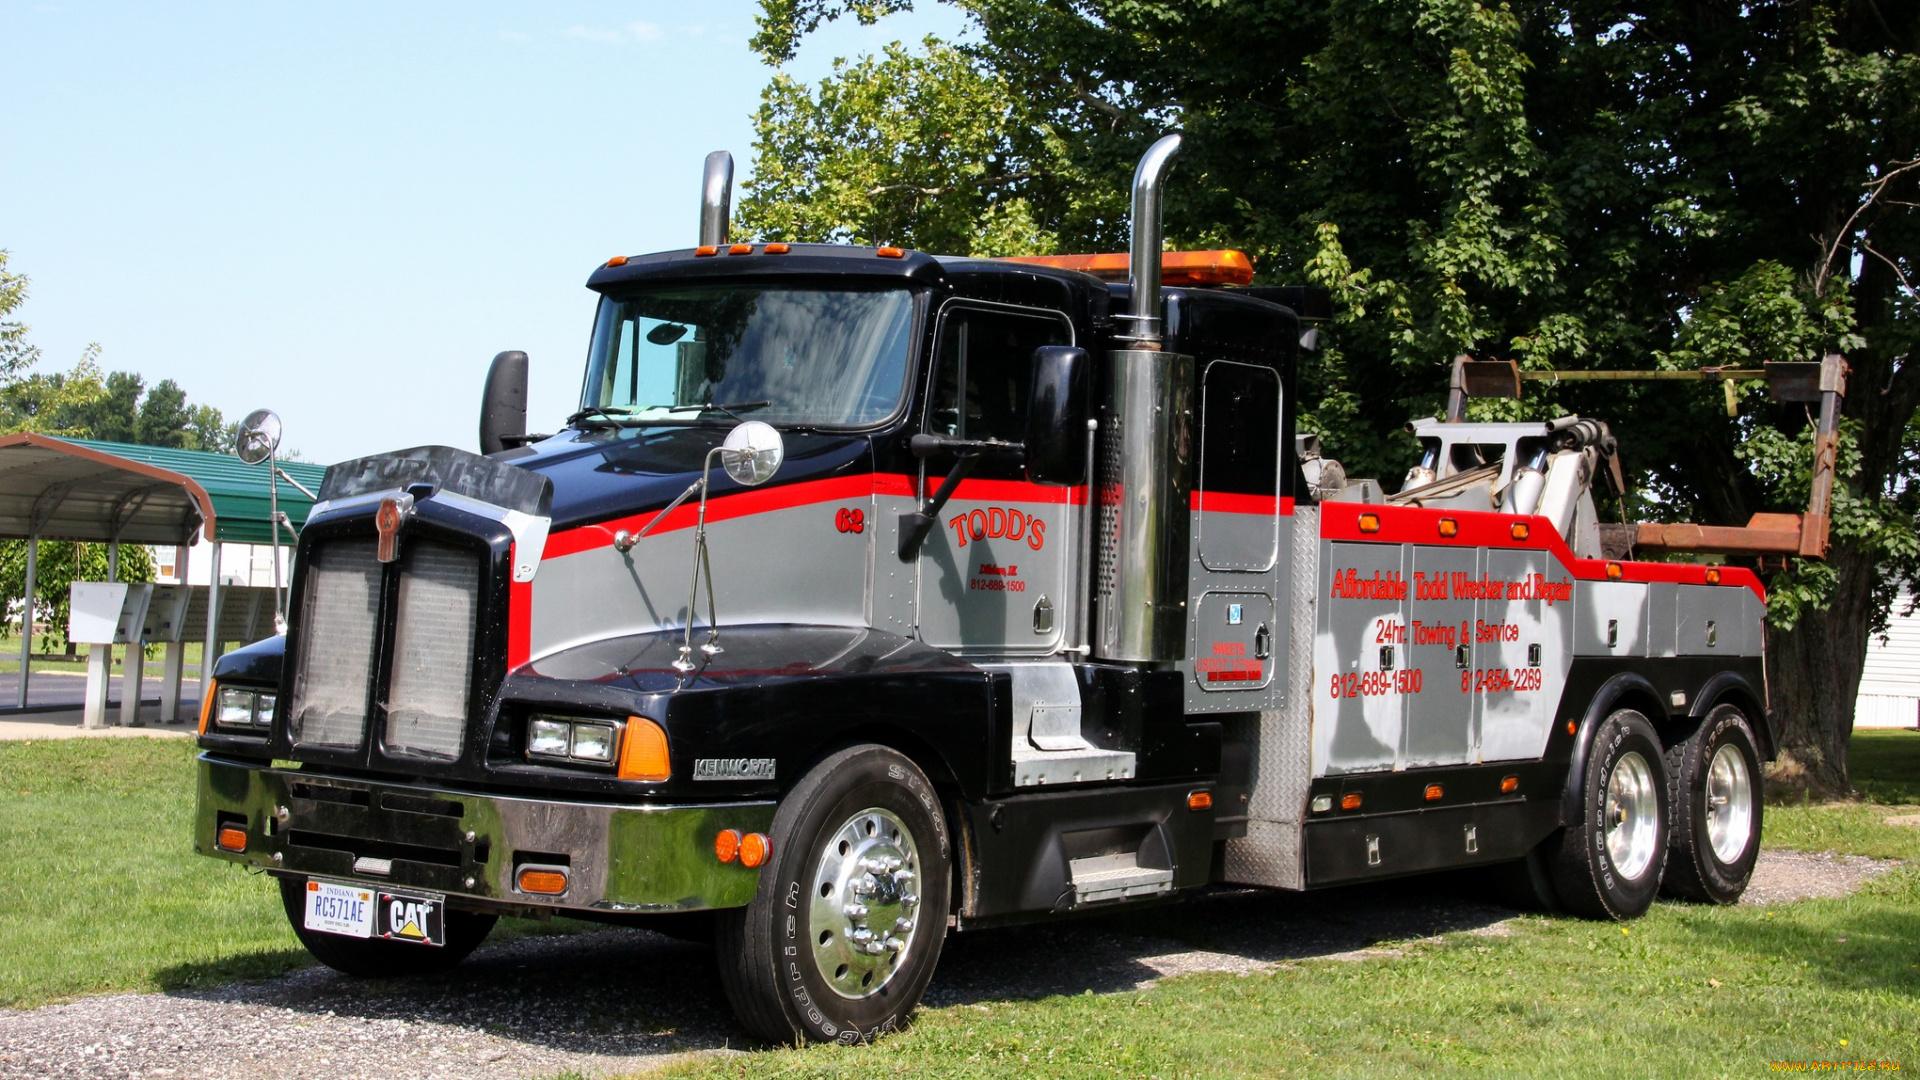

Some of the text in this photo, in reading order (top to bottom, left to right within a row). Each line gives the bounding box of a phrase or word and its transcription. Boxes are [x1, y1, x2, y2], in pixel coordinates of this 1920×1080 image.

[835, 507, 864, 534] 62
[949, 507, 1046, 550] TODD'S
[970, 579, 1025, 592] 812-689-1500
[1331, 569, 1572, 606] Affordable Todd Wrecker and Repair
[1376, 619, 1519, 650] 24hr. Towing & Service
[1330, 668, 1423, 699] 812-689-1500
[1461, 668, 1542, 693] 812-654-2269
[693, 758, 776, 779] KENWORTH
[326, 887, 354, 898] INDIANA
[315, 895, 365, 922] RC571AE
[390, 900, 431, 938] CAT
